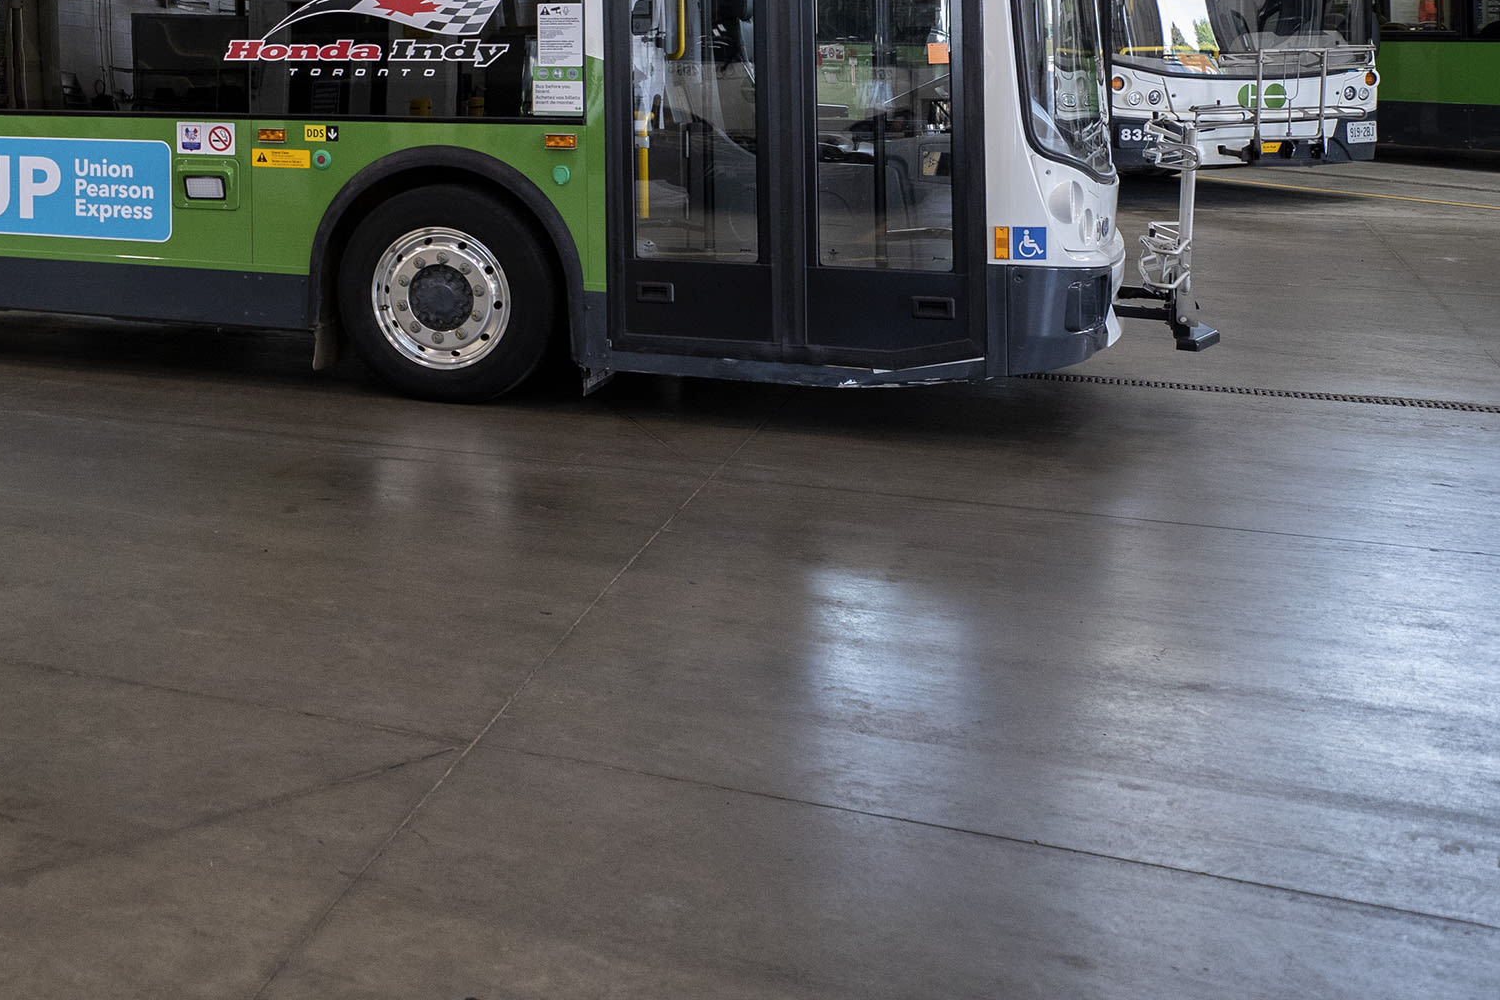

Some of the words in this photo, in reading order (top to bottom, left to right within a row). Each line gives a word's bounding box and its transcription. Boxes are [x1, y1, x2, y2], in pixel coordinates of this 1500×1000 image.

[223, 39, 382, 61] Honda
[387, 39, 510, 68] Indy
[289, 68, 437, 78] TORONTO
[306, 128, 324, 138] DDS
[74, 157, 134, 179] Union
[74, 178, 155, 200] Pearson
[75, 199, 154, 223] Express
